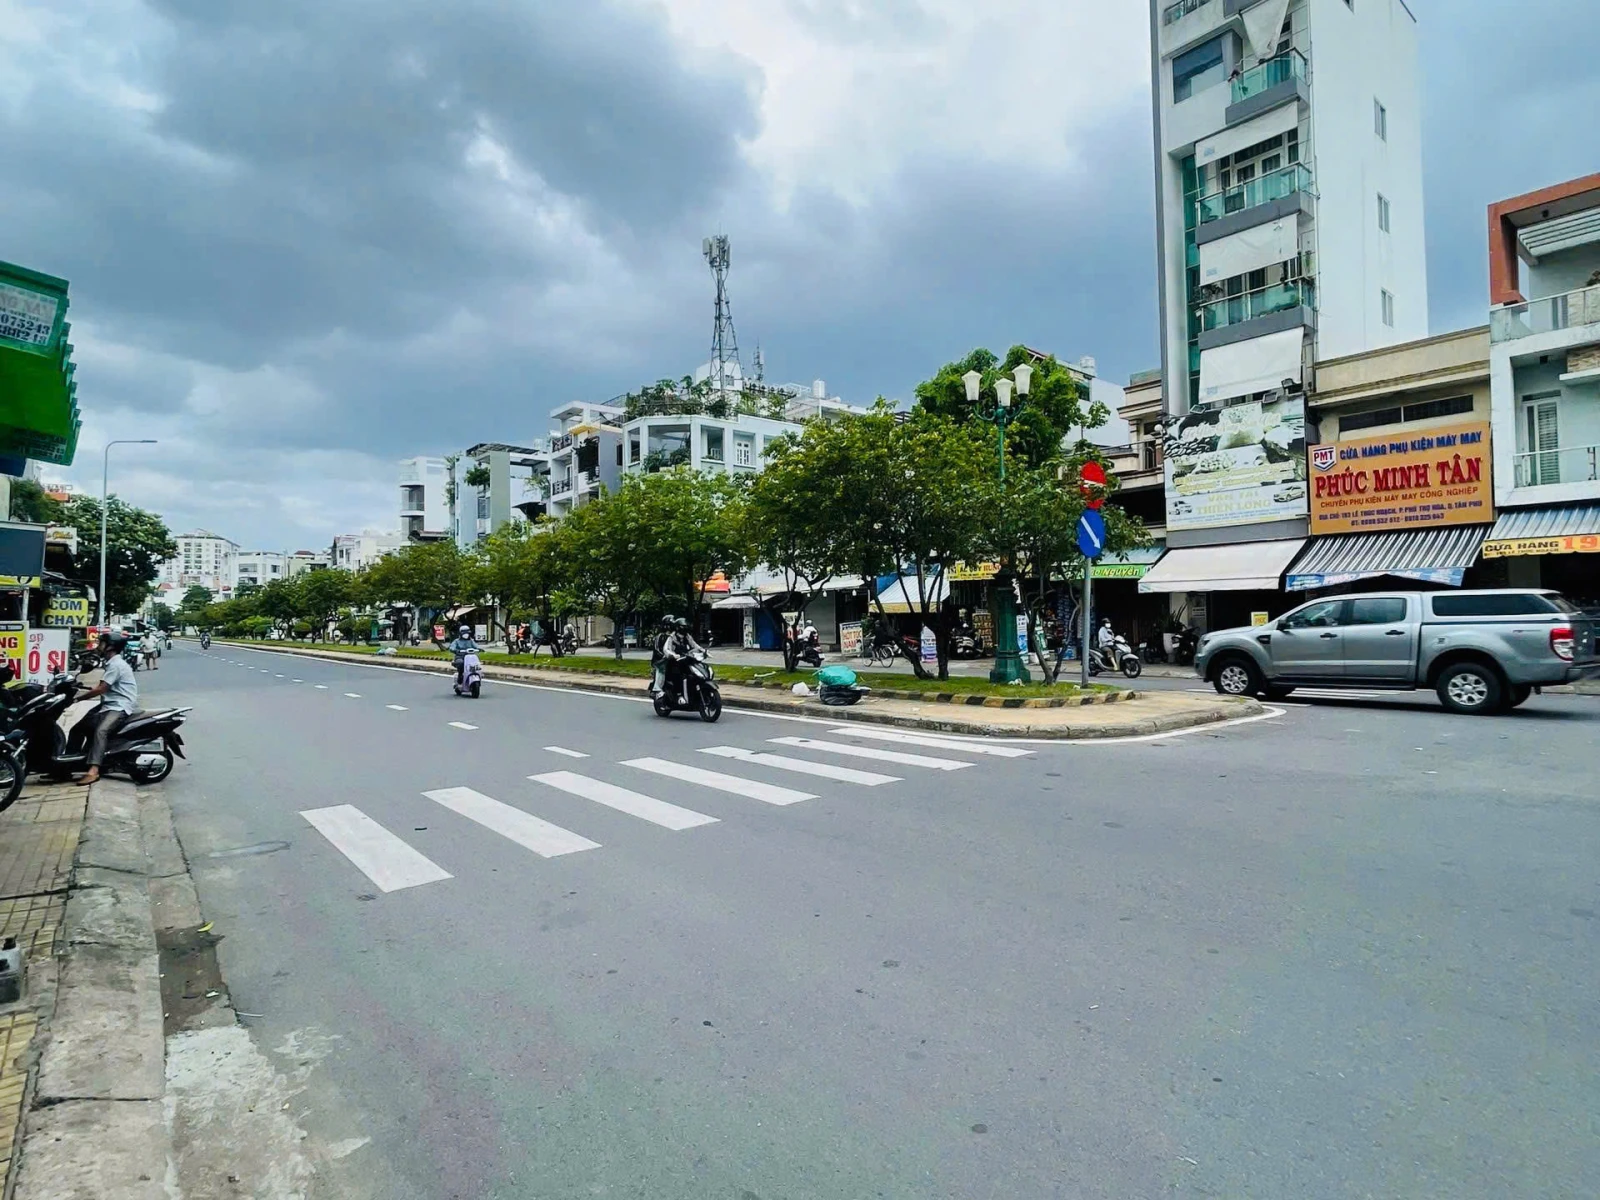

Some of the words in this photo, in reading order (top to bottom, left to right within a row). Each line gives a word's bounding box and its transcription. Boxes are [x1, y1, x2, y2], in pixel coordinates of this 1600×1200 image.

[1340, 445, 1359, 460] CỬA
[1362, 443, 1387, 457] HÀNG
[1389, 442, 1408, 455] PHỤ
[1410, 437, 1434, 452] KIỆN
[1437, 433, 1456, 448] MÁY
[1459, 431, 1482, 445] MAY
[1313, 450, 1334, 462] PMT
[1314, 466, 1369, 498] PHÚC
[1373, 463, 1431, 493] MINH
[1436, 453, 1483, 486] TÂN
[1320, 498, 1349, 508] CHUYÊN
[1349, 498, 1364, 507] PHỤ
[1365, 495, 1382, 504] KIỆN
[1401, 492, 1418, 501] MAY
[1420, 488, 1443, 499] CÔNG
[1447, 486, 1479, 496] NGHIỆP
[1484, 542, 1513, 552] CỬA
[50, 599, 82, 611] CƠM
[44, 614, 85, 625] CHAY
